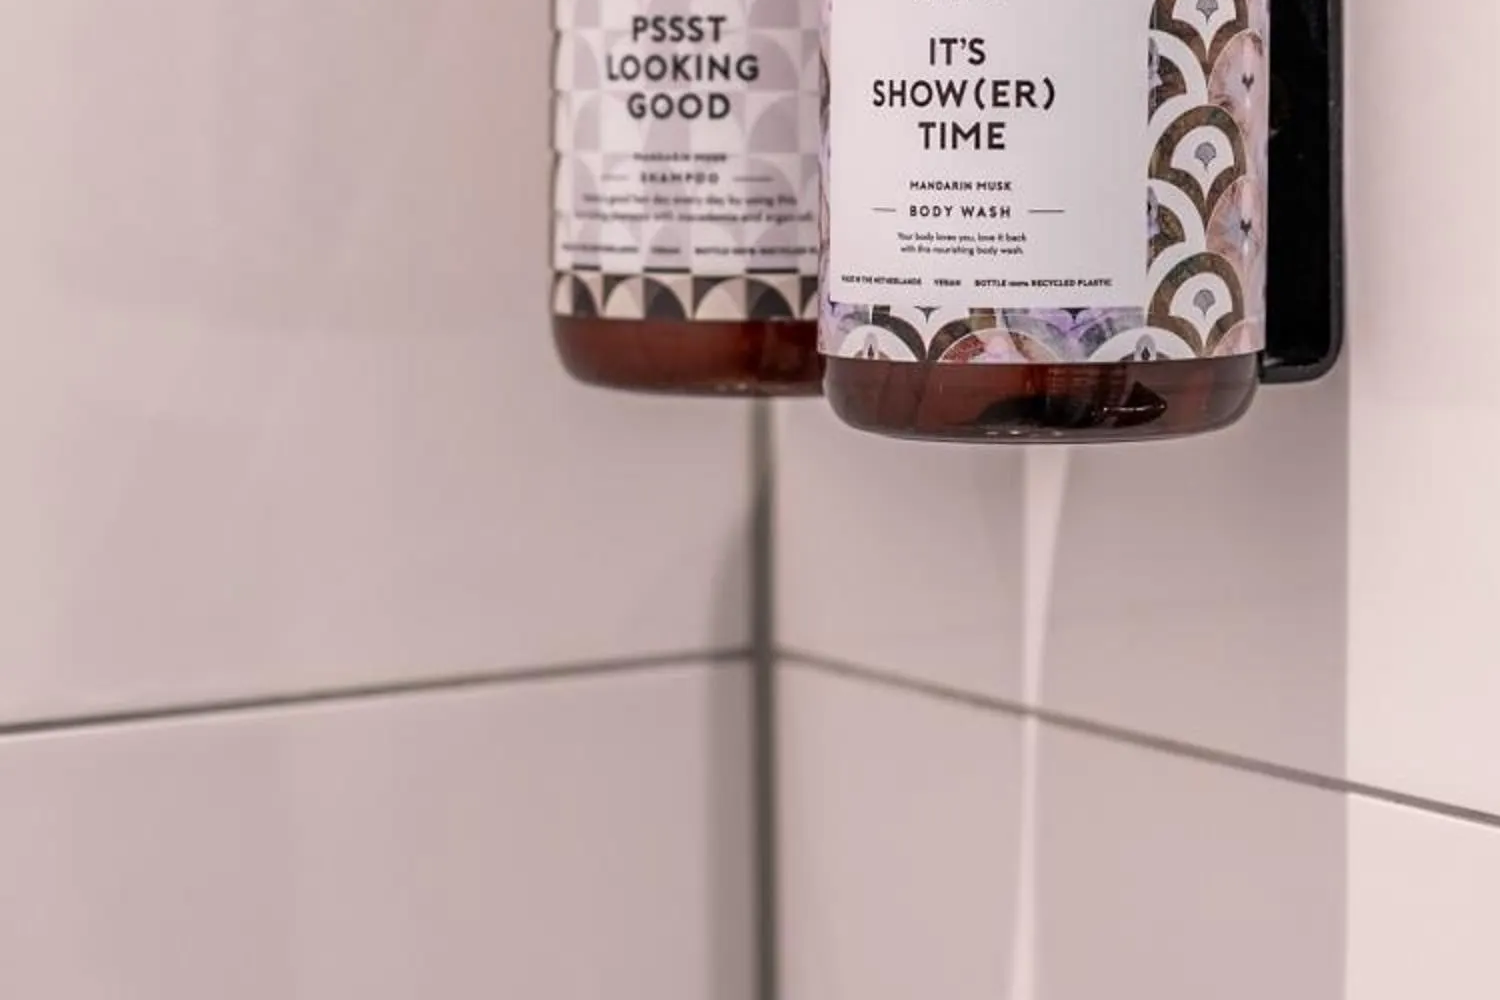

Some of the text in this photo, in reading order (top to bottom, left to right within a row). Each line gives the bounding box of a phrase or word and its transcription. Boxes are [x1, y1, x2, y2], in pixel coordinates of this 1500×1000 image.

[632, 15, 727, 42] PSSST
[929, 37, 986, 66] IT'S
[607, 53, 760, 81] LOOKING
[627, 92, 731, 120] GOOD
[872, 77, 1055, 110] SHOW(ER)
[917, 121, 1006, 150] TIME
[640, 172, 720, 184] SHAMPOO
[909, 180, 1012, 192] MANDARIN MUSK
[909, 205, 1011, 218] BODY WASH
[915, 232, 934, 242] body
[1006, 232, 1026, 241] back
[974, 279, 1006, 288] BOTTLE
[1031, 279, 1076, 288] RECYCLED
[1077, 279, 1113, 288] PLASTIC
